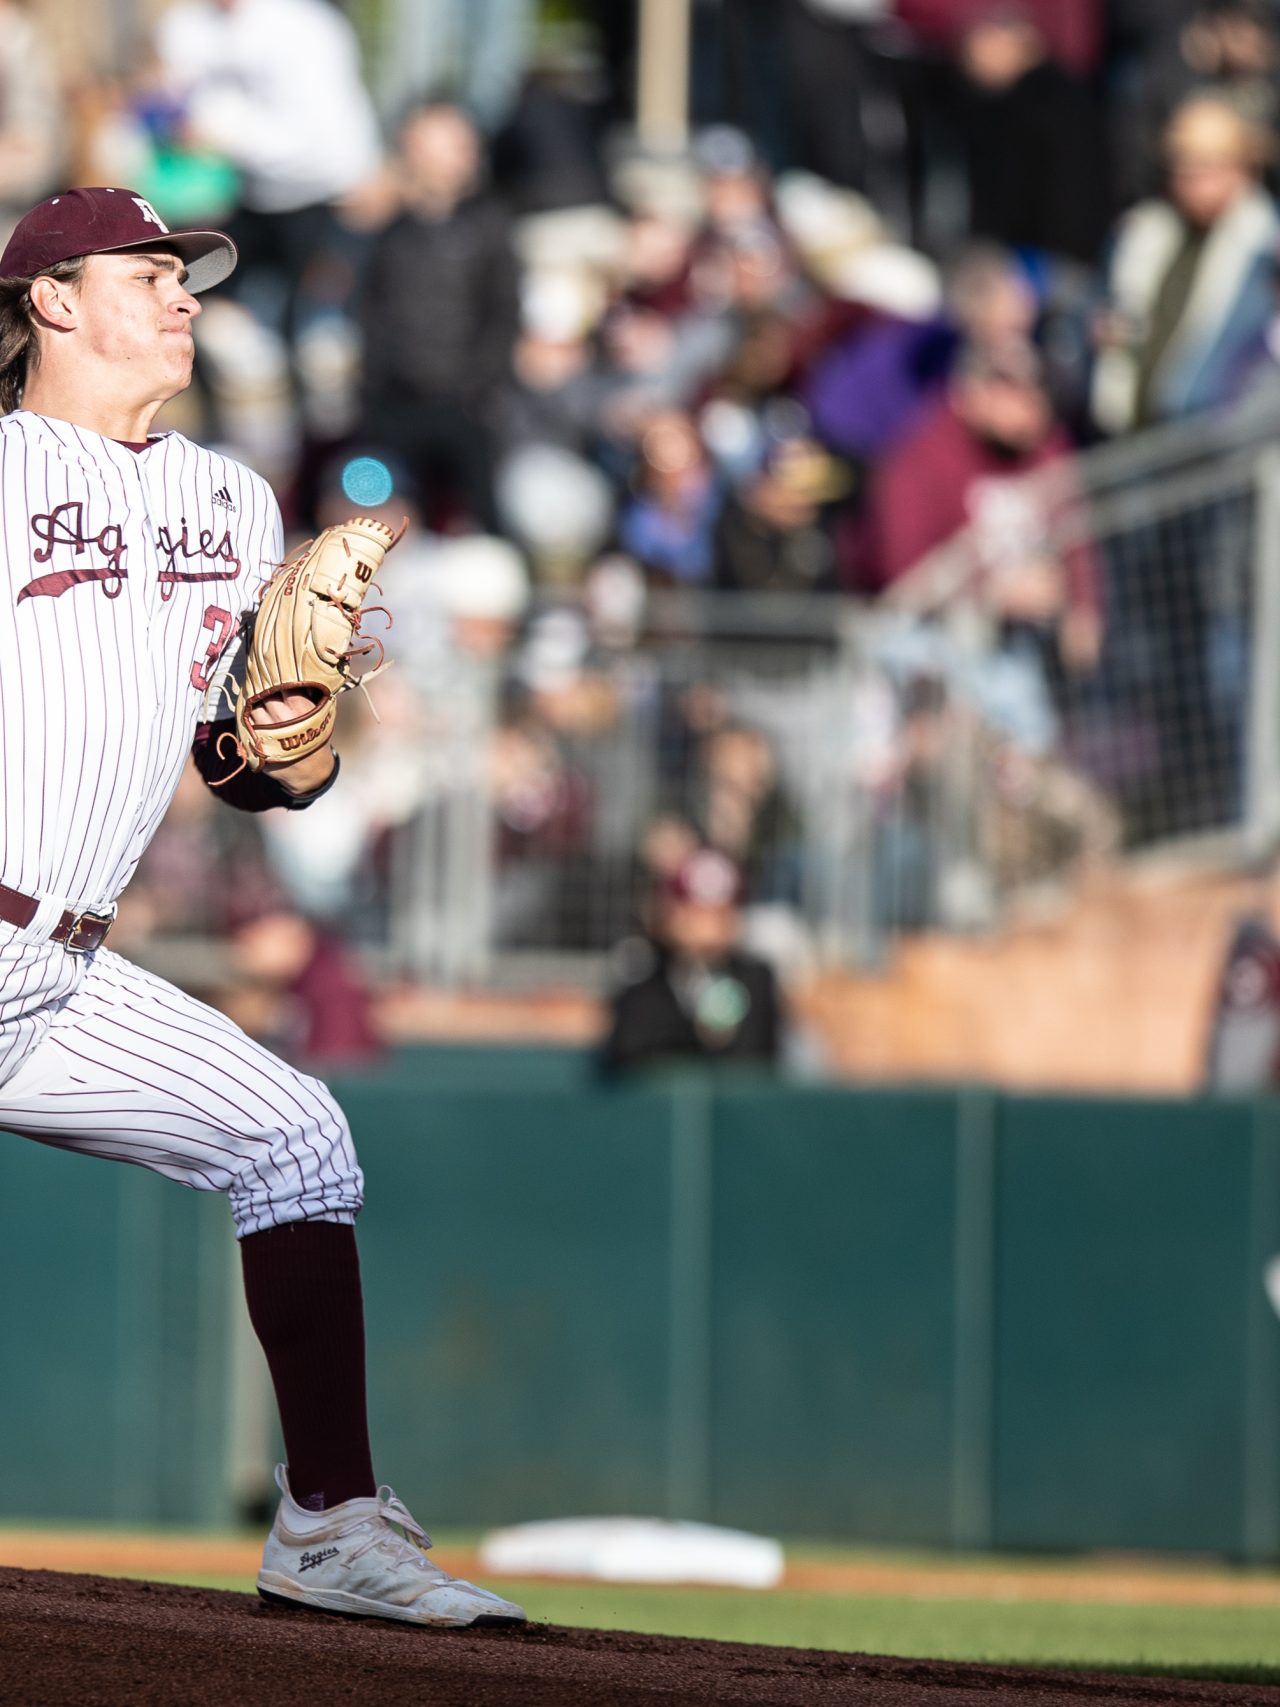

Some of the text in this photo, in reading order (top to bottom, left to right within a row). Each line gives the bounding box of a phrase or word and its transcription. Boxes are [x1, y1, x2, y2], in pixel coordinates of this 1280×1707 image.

[211, 496, 237, 513] adidas
[277, 712, 331, 751] Wilson
[299, 1546, 340, 1573] Aggies
